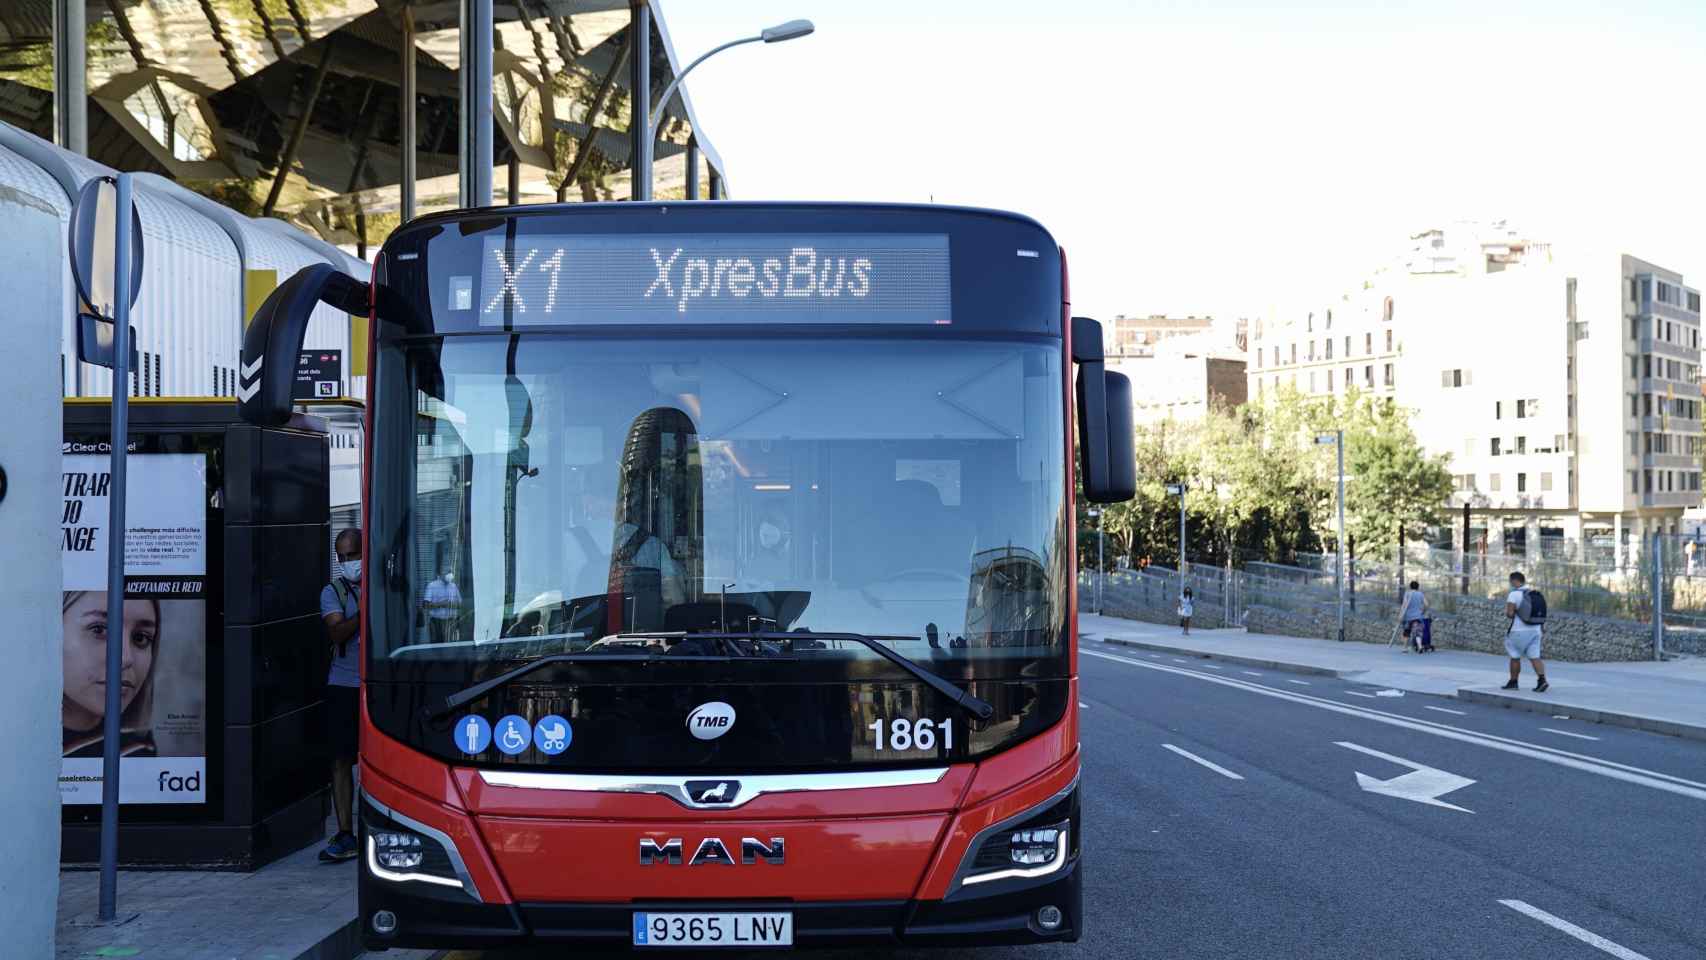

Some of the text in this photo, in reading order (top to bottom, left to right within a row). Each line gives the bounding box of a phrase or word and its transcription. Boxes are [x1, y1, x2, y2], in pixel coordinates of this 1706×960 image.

[484, 248, 872, 312] X1 XpresBus
[72, 442, 137, 452] Clear Chel
[62, 472, 111, 497] TRAR
[125, 581, 202, 593] ACEPTAMOS EL RETO
[696, 716, 729, 728] TMB
[868, 718, 953, 751] 1861
[157, 770, 200, 792] fad
[639, 837, 785, 865] MAN
[638, 931, 645, 940] E
[653, 917, 785, 942] 9365 LNV
